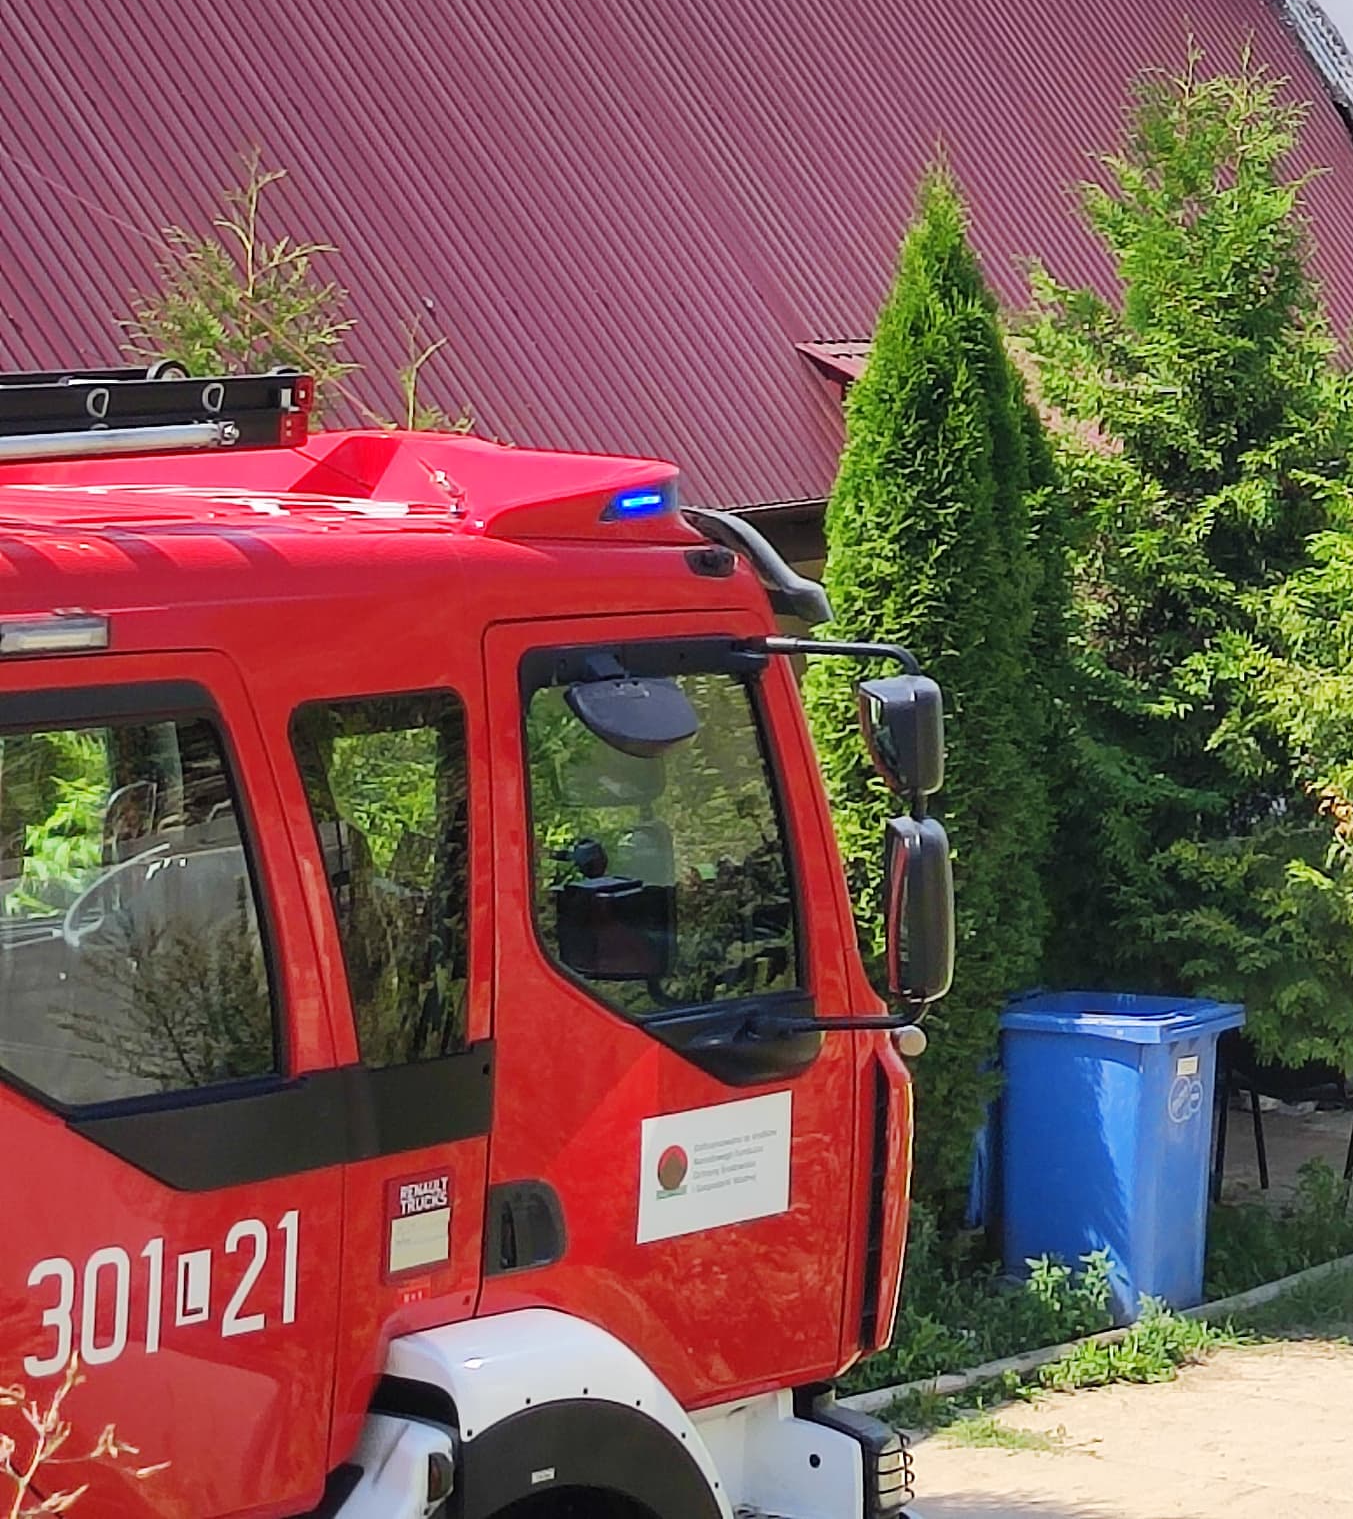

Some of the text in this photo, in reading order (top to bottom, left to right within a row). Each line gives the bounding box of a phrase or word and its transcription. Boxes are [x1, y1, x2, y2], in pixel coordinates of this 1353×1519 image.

[400, 1176, 449, 1201] RENAULT
[400, 1192, 448, 1216] TRUCKS
[23, 1237, 164, 1378] 301
[221, 1210, 299, 1338] 21
